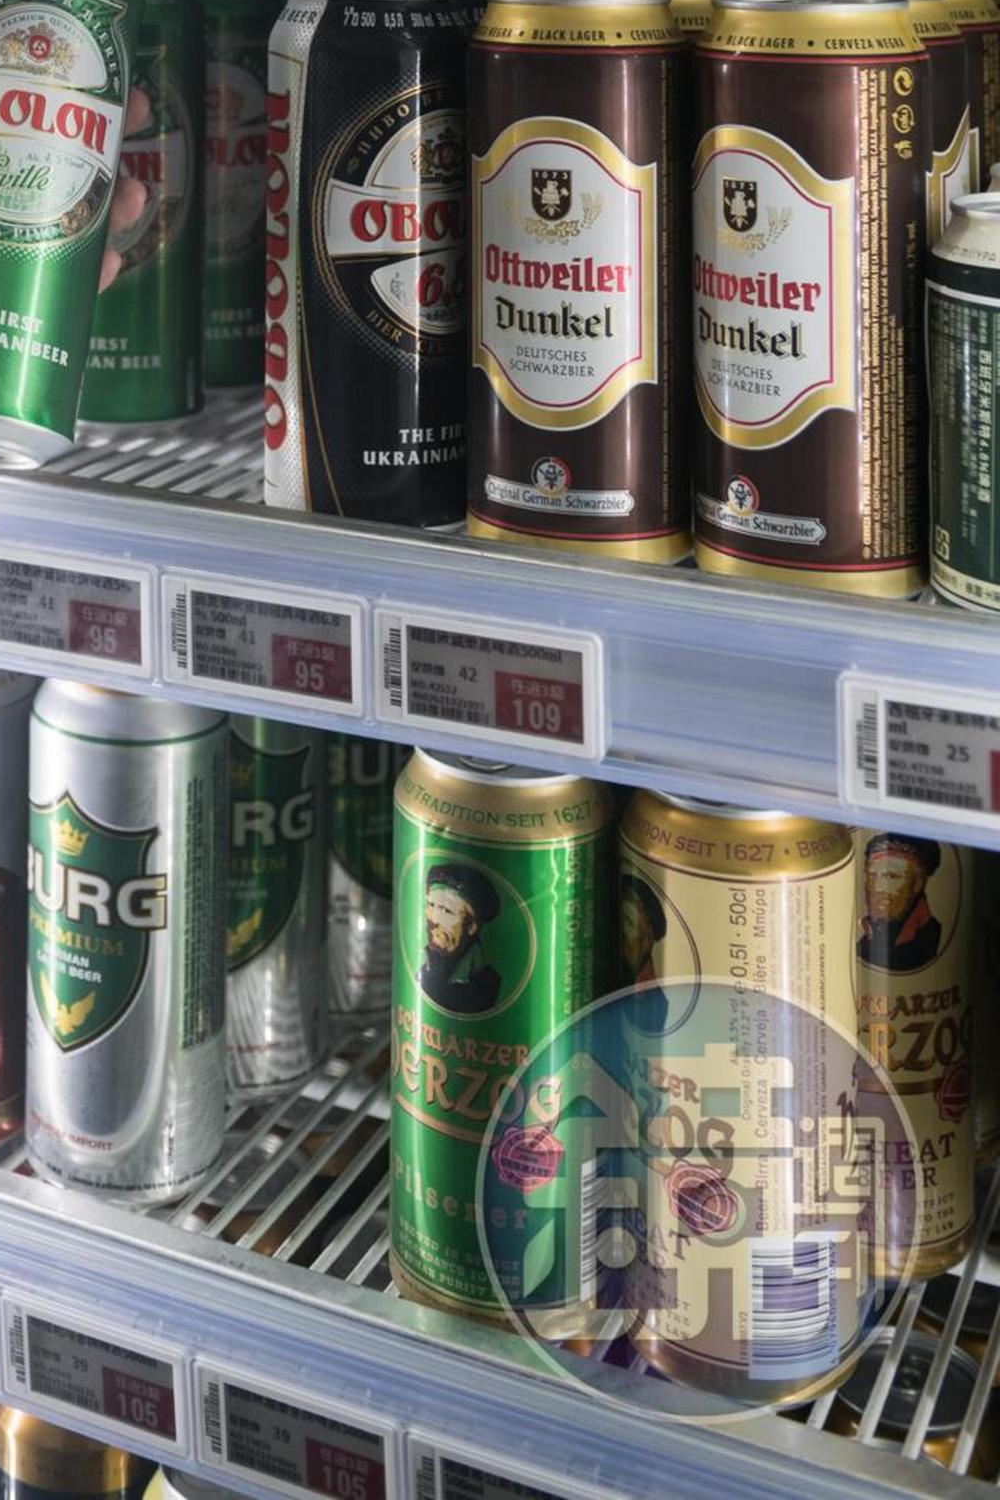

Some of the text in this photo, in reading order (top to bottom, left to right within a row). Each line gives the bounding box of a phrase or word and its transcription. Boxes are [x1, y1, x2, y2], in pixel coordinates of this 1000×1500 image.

[531, 30, 566, 42] BLACK
[569, 29, 606, 42] LAGER
[726, 36, 758, 49] BLACK
[759, 37, 796, 49] LAGER
[825, 37, 873, 51] CERVEZA
[349, 198, 462, 243] OBO
[485, 242, 634, 296] Ottweiler
[493, 296, 615, 340] Dunkel
[697, 306, 804, 360] Dunkel
[28, 342, 70, 369] BEER
[515, 344, 588, 362] DEUTSCHES
[508, 360, 595, 380] SCHWARZBIER
[399, 422, 468, 445] THE FIR
[362, 446, 468, 467] UKRAINIA
[522, 489, 628, 514] German Schwarzbier
[752, 516, 817, 540] Schwarzbier
[210, 609, 247, 627] 500ml
[89, 626, 117, 655] 95
[294, 660, 325, 691] 95
[458, 667, 478, 683] 42
[512, 700, 561, 733] 109
[947, 743, 970, 762] 25
[414, 788, 592, 830] TRADITION SEIT 1627
[675, 835, 775, 864] SEIT 1627
[68, 965, 103, 984] BEER
[755, 1010, 769, 1065] Cerveja
[756, 1079, 768, 1139] Cerveza
[72, 1355, 89, 1372] 39
[118, 1392, 159, 1428] 105
[273, 1426, 291, 1445] 39
[322, 1465, 367, 1499] 105
